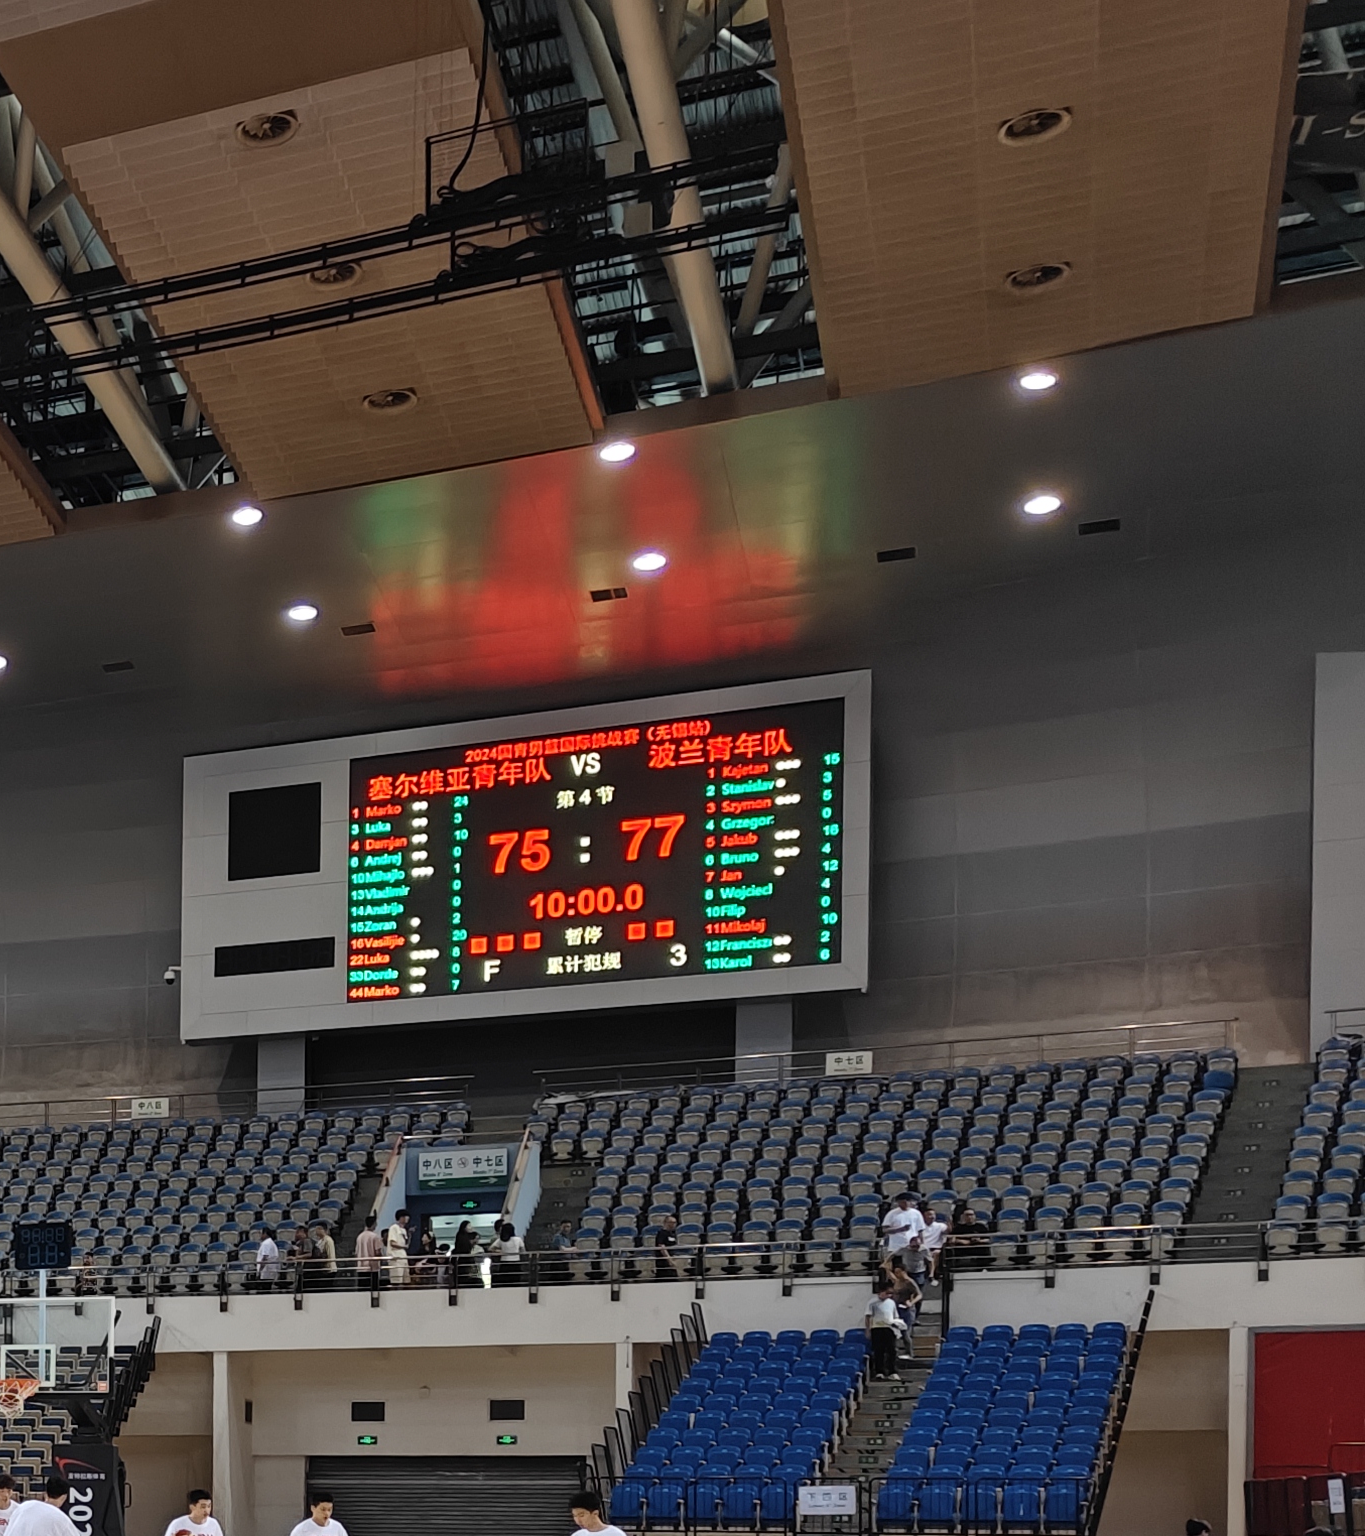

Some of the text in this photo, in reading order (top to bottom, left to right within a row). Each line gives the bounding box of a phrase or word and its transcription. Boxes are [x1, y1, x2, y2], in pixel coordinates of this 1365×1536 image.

[648, 728, 793, 769] 波兰青年队
[570, 752, 602, 777] VS
[369, 757, 552, 801] 塞尔维亚青年队
[706, 784, 716, 797] 2
[822, 771, 833, 784] 3
[365, 804, 402, 818] Marko
[453, 795, 469, 808] 24
[706, 801, 716, 815] 3
[351, 812, 463, 835] 3 Luka 3
[705, 806, 832, 831] 4 Grzegor 0
[350, 840, 360, 852] 4
[453, 828, 469, 841] 10
[488, 828, 551, 875] 75
[620, 814, 686, 862] 77
[452, 846, 462, 858] 0
[720, 852, 760, 865] Bruno
[821, 842, 832, 854] 4
[704, 870, 716, 883] 7
[822, 859, 839, 872] 12
[452, 879, 462, 891] 0
[820, 877, 831, 889] 4
[351, 905, 364, 917] 14
[452, 895, 462, 907] 0
[529, 882, 644, 920] 10:00.0
[705, 906, 720, 918] 10
[820, 895, 831, 908] 0
[364, 920, 397, 933] Zoran
[452, 912, 461, 925] 2
[705, 922, 720, 934] 11
[821, 912, 839, 925] 10
[564, 925, 604, 947] 暂停
[705, 940, 720, 952] 12
[820, 930, 831, 943] 2
[349, 955, 364, 966] 22
[364, 952, 391, 965] Luka
[452, 962, 461, 974] 0
[482, 942, 688, 983] F 累计犯规 3
[720, 954, 753, 969] Karol
[349, 979, 460, 998] 44 Marko 7
[834, 1055, 864, 1066] 中七区
[422, 1155, 504, 1171] 中八区 中七区
